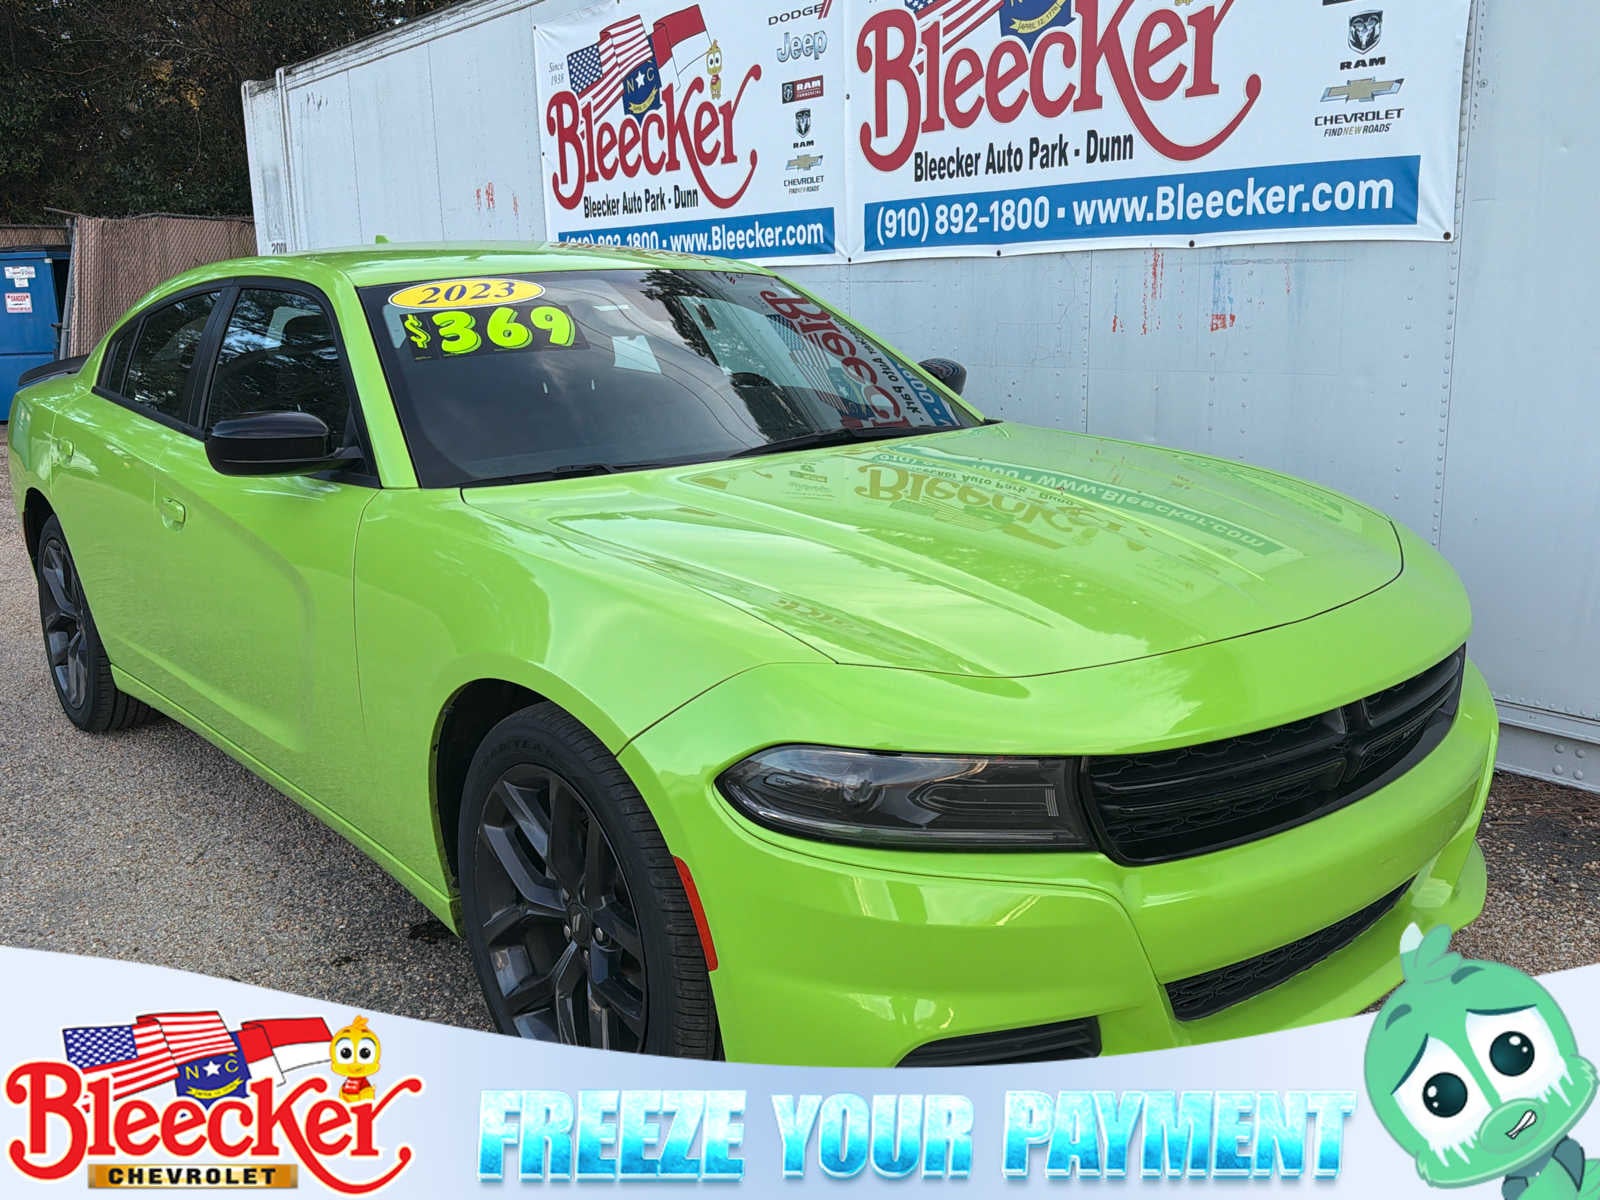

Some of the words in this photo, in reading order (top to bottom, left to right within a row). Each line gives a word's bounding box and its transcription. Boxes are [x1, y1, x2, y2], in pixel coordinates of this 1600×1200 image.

[768, 3, 823, 25] DODGE
[776, 30, 828, 62] Jeep
[1340, 56, 1386, 70] RAM
[796, 79, 820, 91] RAM
[857, 0, 1262, 171] Bleecker
[1314, 108, 1405, 127] CHEVROLET
[546, 64, 762, 210] Bleecker
[793, 140, 815, 149] RAM
[914, 147, 980, 182] Bleecker
[985, 142, 1024, 174] Auto
[1028, 133, 1069, 170] Park
[1086, 129, 1134, 163] Dunn
[783, 175, 825, 187] CHEVROLET
[584, 193, 620, 219] Bleecker
[622, 190, 643, 215] Auto
[644, 187, 666, 213] Park
[674, 184, 699, 209] Dunn
[876, 202, 930, 245] (910)
[934, 196, 1050, 235] 892-1800
[1073, 177, 1394, 226] www.Bleecker.com
[670, 221, 824, 252] www.Bleecker.com
[417, 281, 516, 305] 2023
[404, 306, 576, 355] $369
